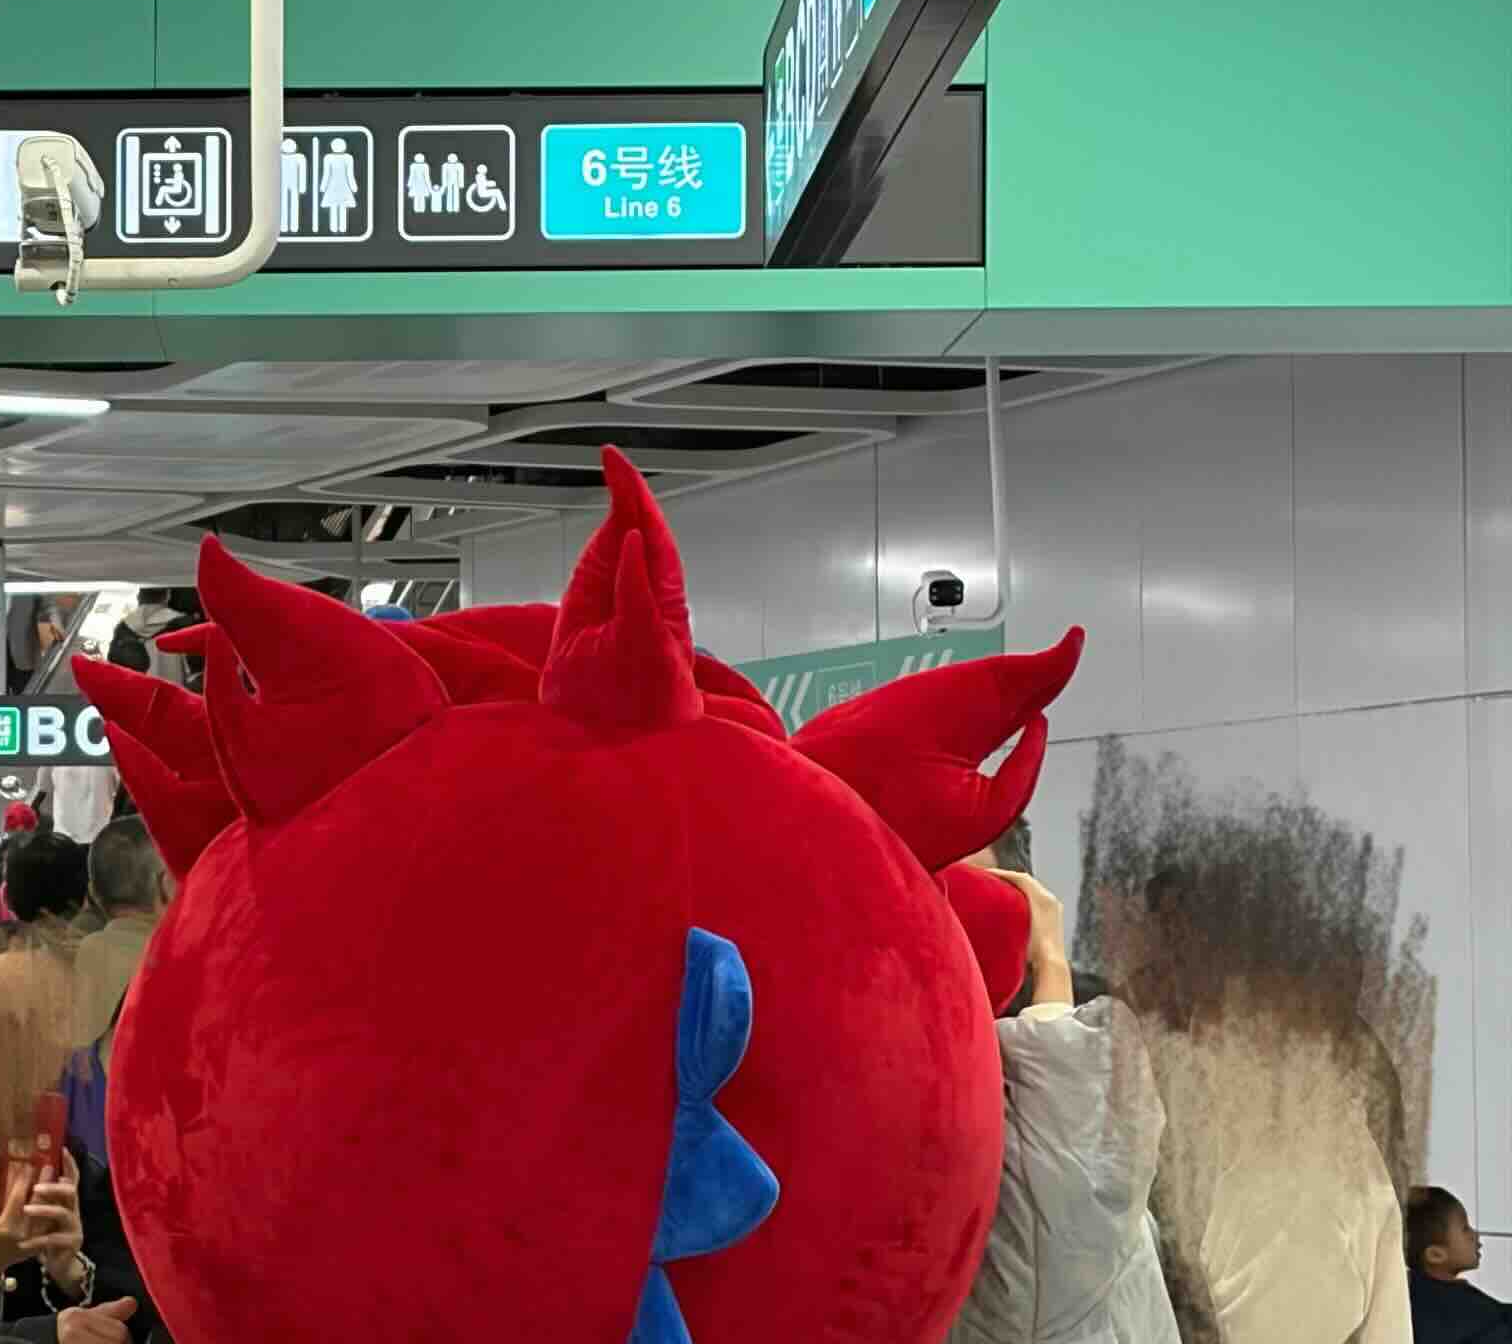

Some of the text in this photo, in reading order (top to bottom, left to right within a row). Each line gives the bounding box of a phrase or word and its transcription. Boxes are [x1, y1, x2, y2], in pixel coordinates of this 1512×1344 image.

[581, 144, 704, 191] 6号线
[604, 196, 682, 219] Line 6
